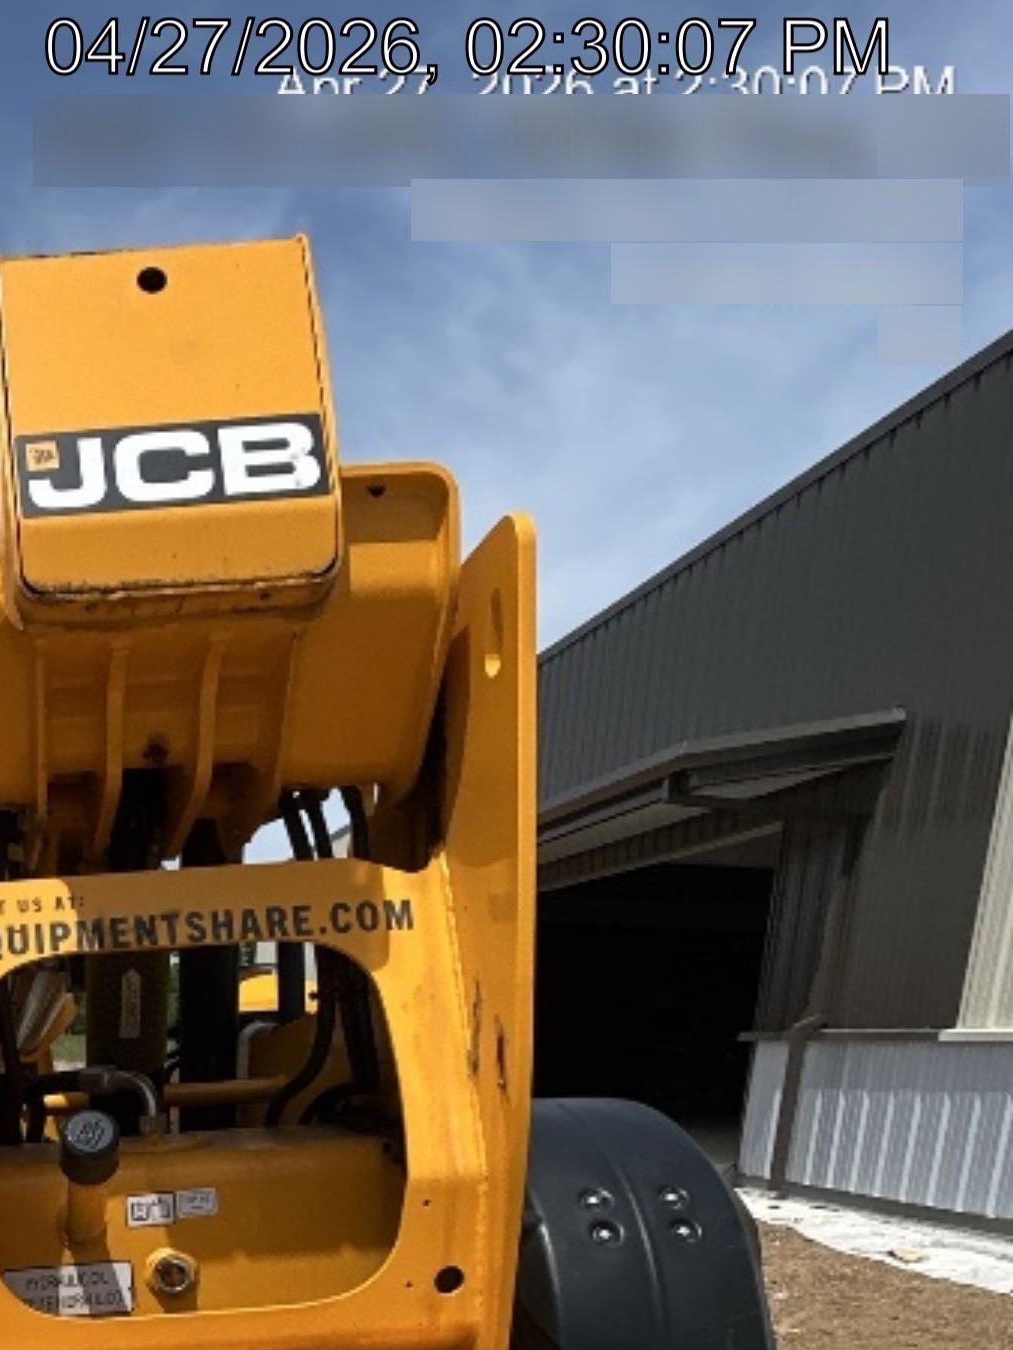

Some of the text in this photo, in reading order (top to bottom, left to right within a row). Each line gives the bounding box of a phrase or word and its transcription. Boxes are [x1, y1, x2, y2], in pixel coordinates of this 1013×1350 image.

[27, 422, 321, 509] JCB
[17, 896, 42, 913] US
[54, 895, 84, 911] AT:
